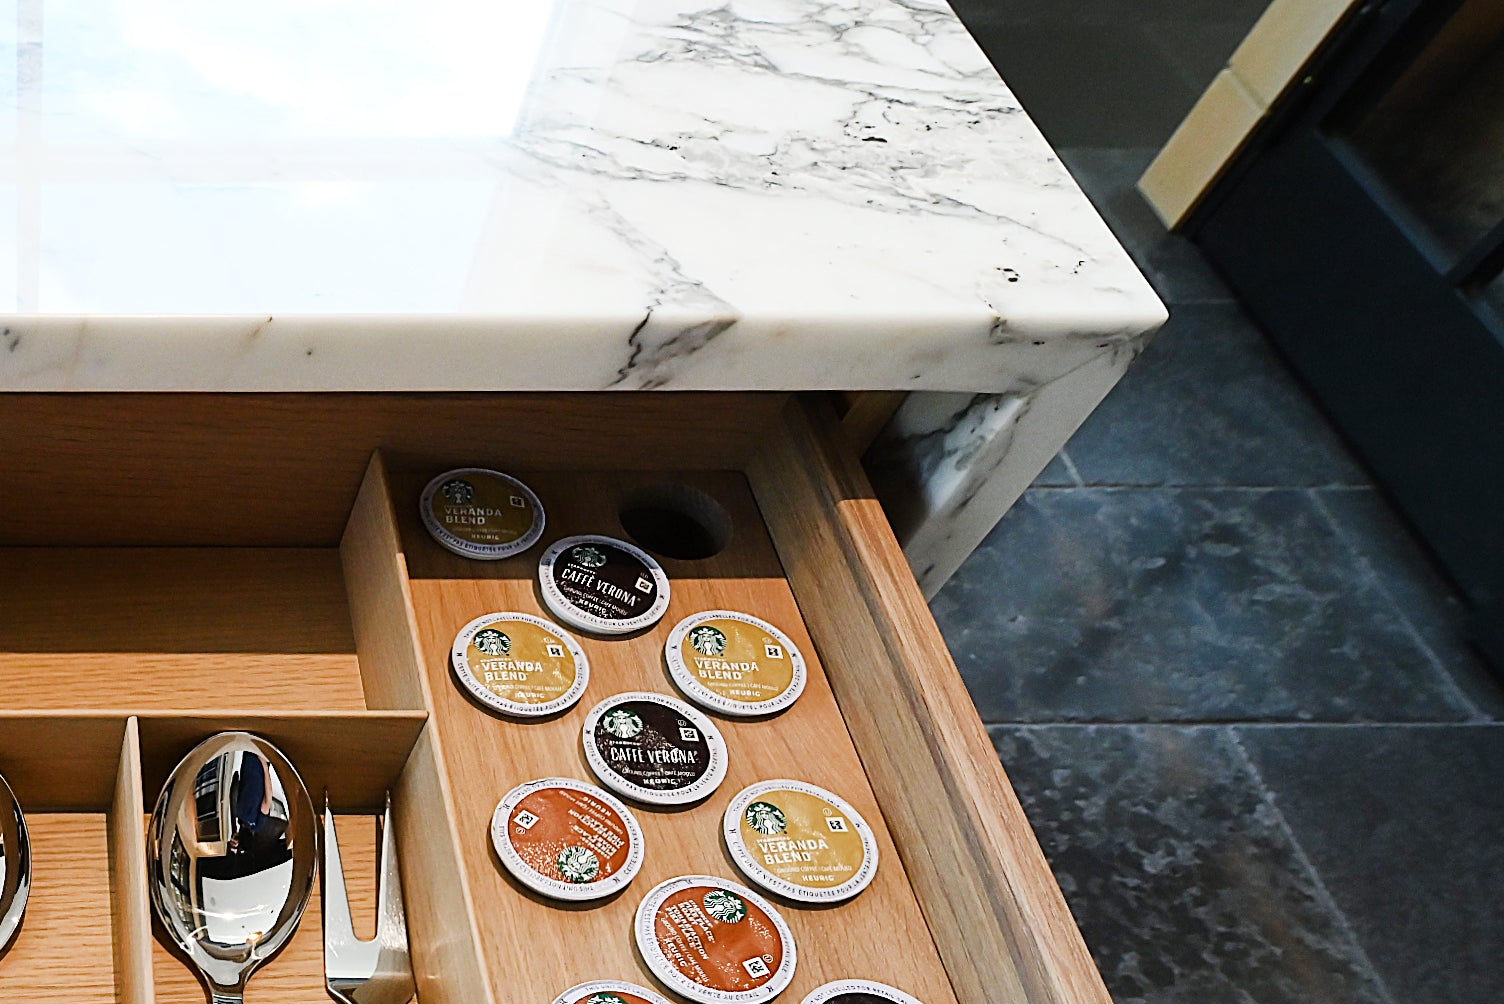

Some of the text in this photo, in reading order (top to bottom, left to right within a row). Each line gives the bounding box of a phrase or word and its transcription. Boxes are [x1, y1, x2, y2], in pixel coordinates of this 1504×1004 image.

[444, 508, 502, 517] VERANDA
[446, 516, 486, 525] BLEND
[596, 579, 636, 607] VERONA
[482, 662, 543, 672] VERANDA
[695, 660, 760, 672] VERANDA
[485, 672, 527, 681] BLEND
[698, 670, 743, 680] BLEND
[647, 748, 695, 764] VERONA
[582, 794, 612, 817] KEURIG
[759, 839, 829, 853] VERANDA
[764, 851, 811, 865] BLEND
[663, 937, 688, 967] KEURIG
